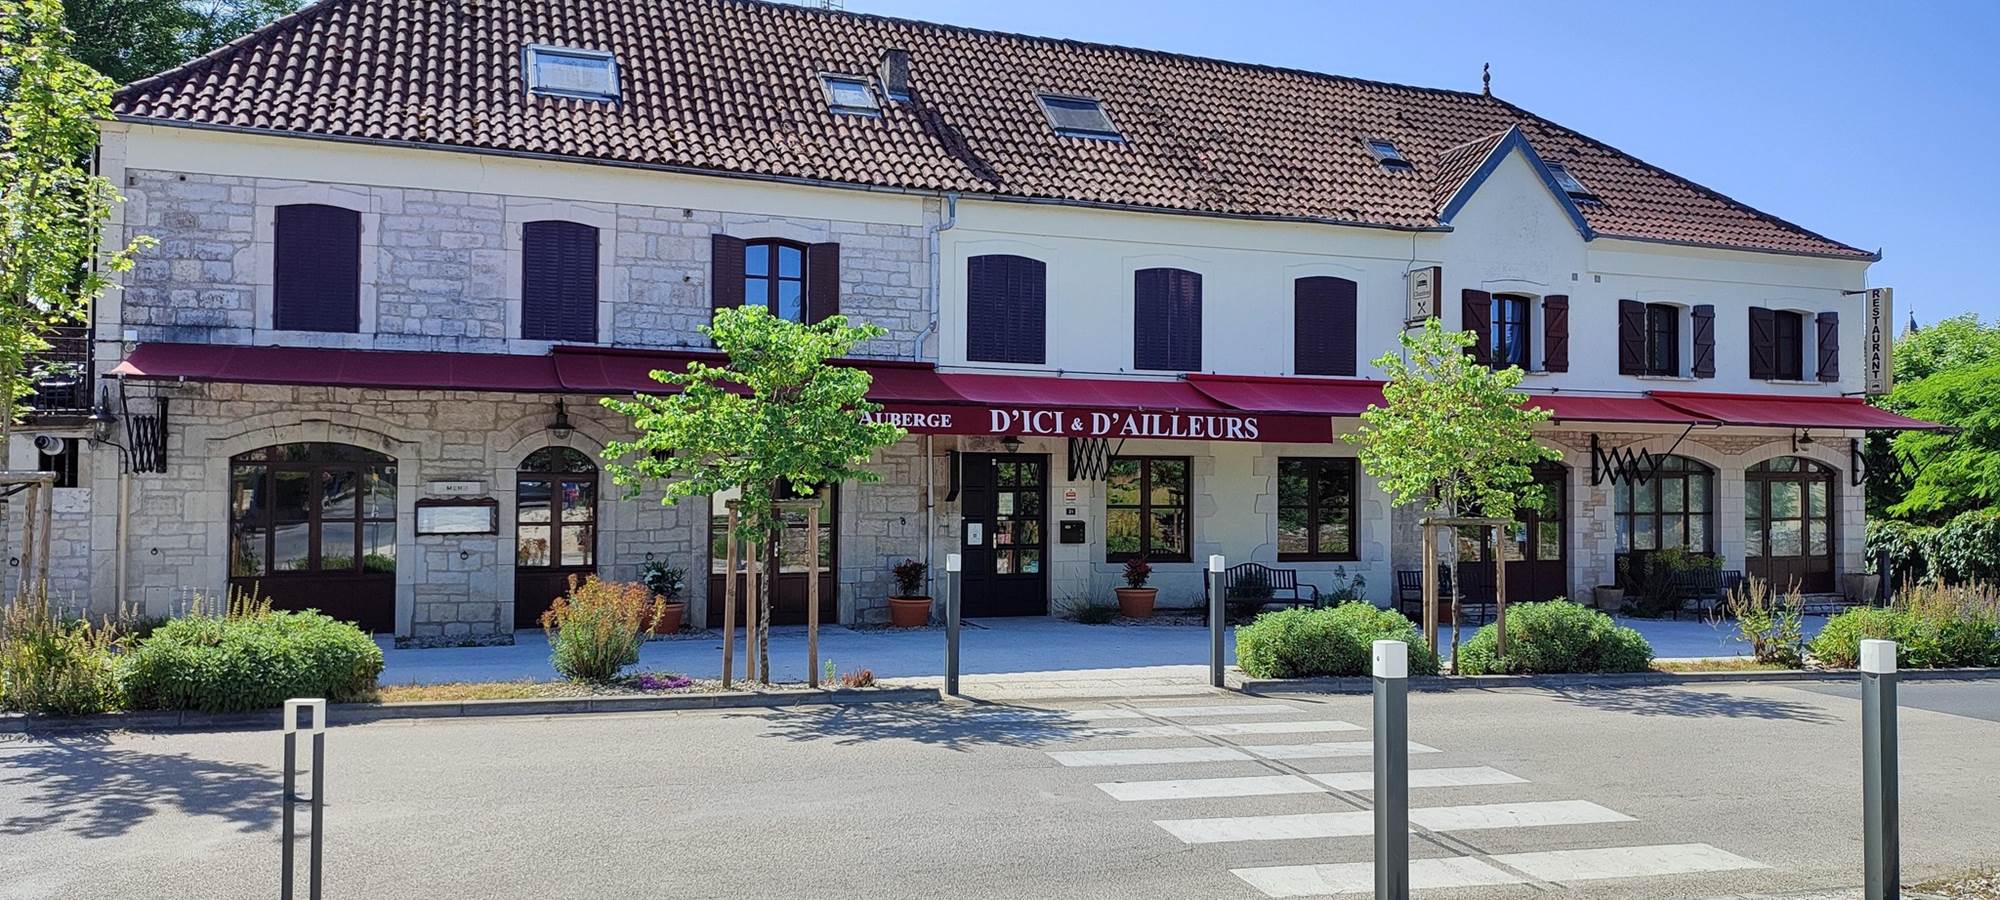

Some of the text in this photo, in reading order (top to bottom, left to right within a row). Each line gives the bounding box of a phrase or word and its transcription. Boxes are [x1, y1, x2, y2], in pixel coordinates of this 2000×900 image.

[1872, 289, 1880, 379] RESTAURANT
[859, 409, 1259, 440] AUBERGE D'ICI & D'AILLEURS
